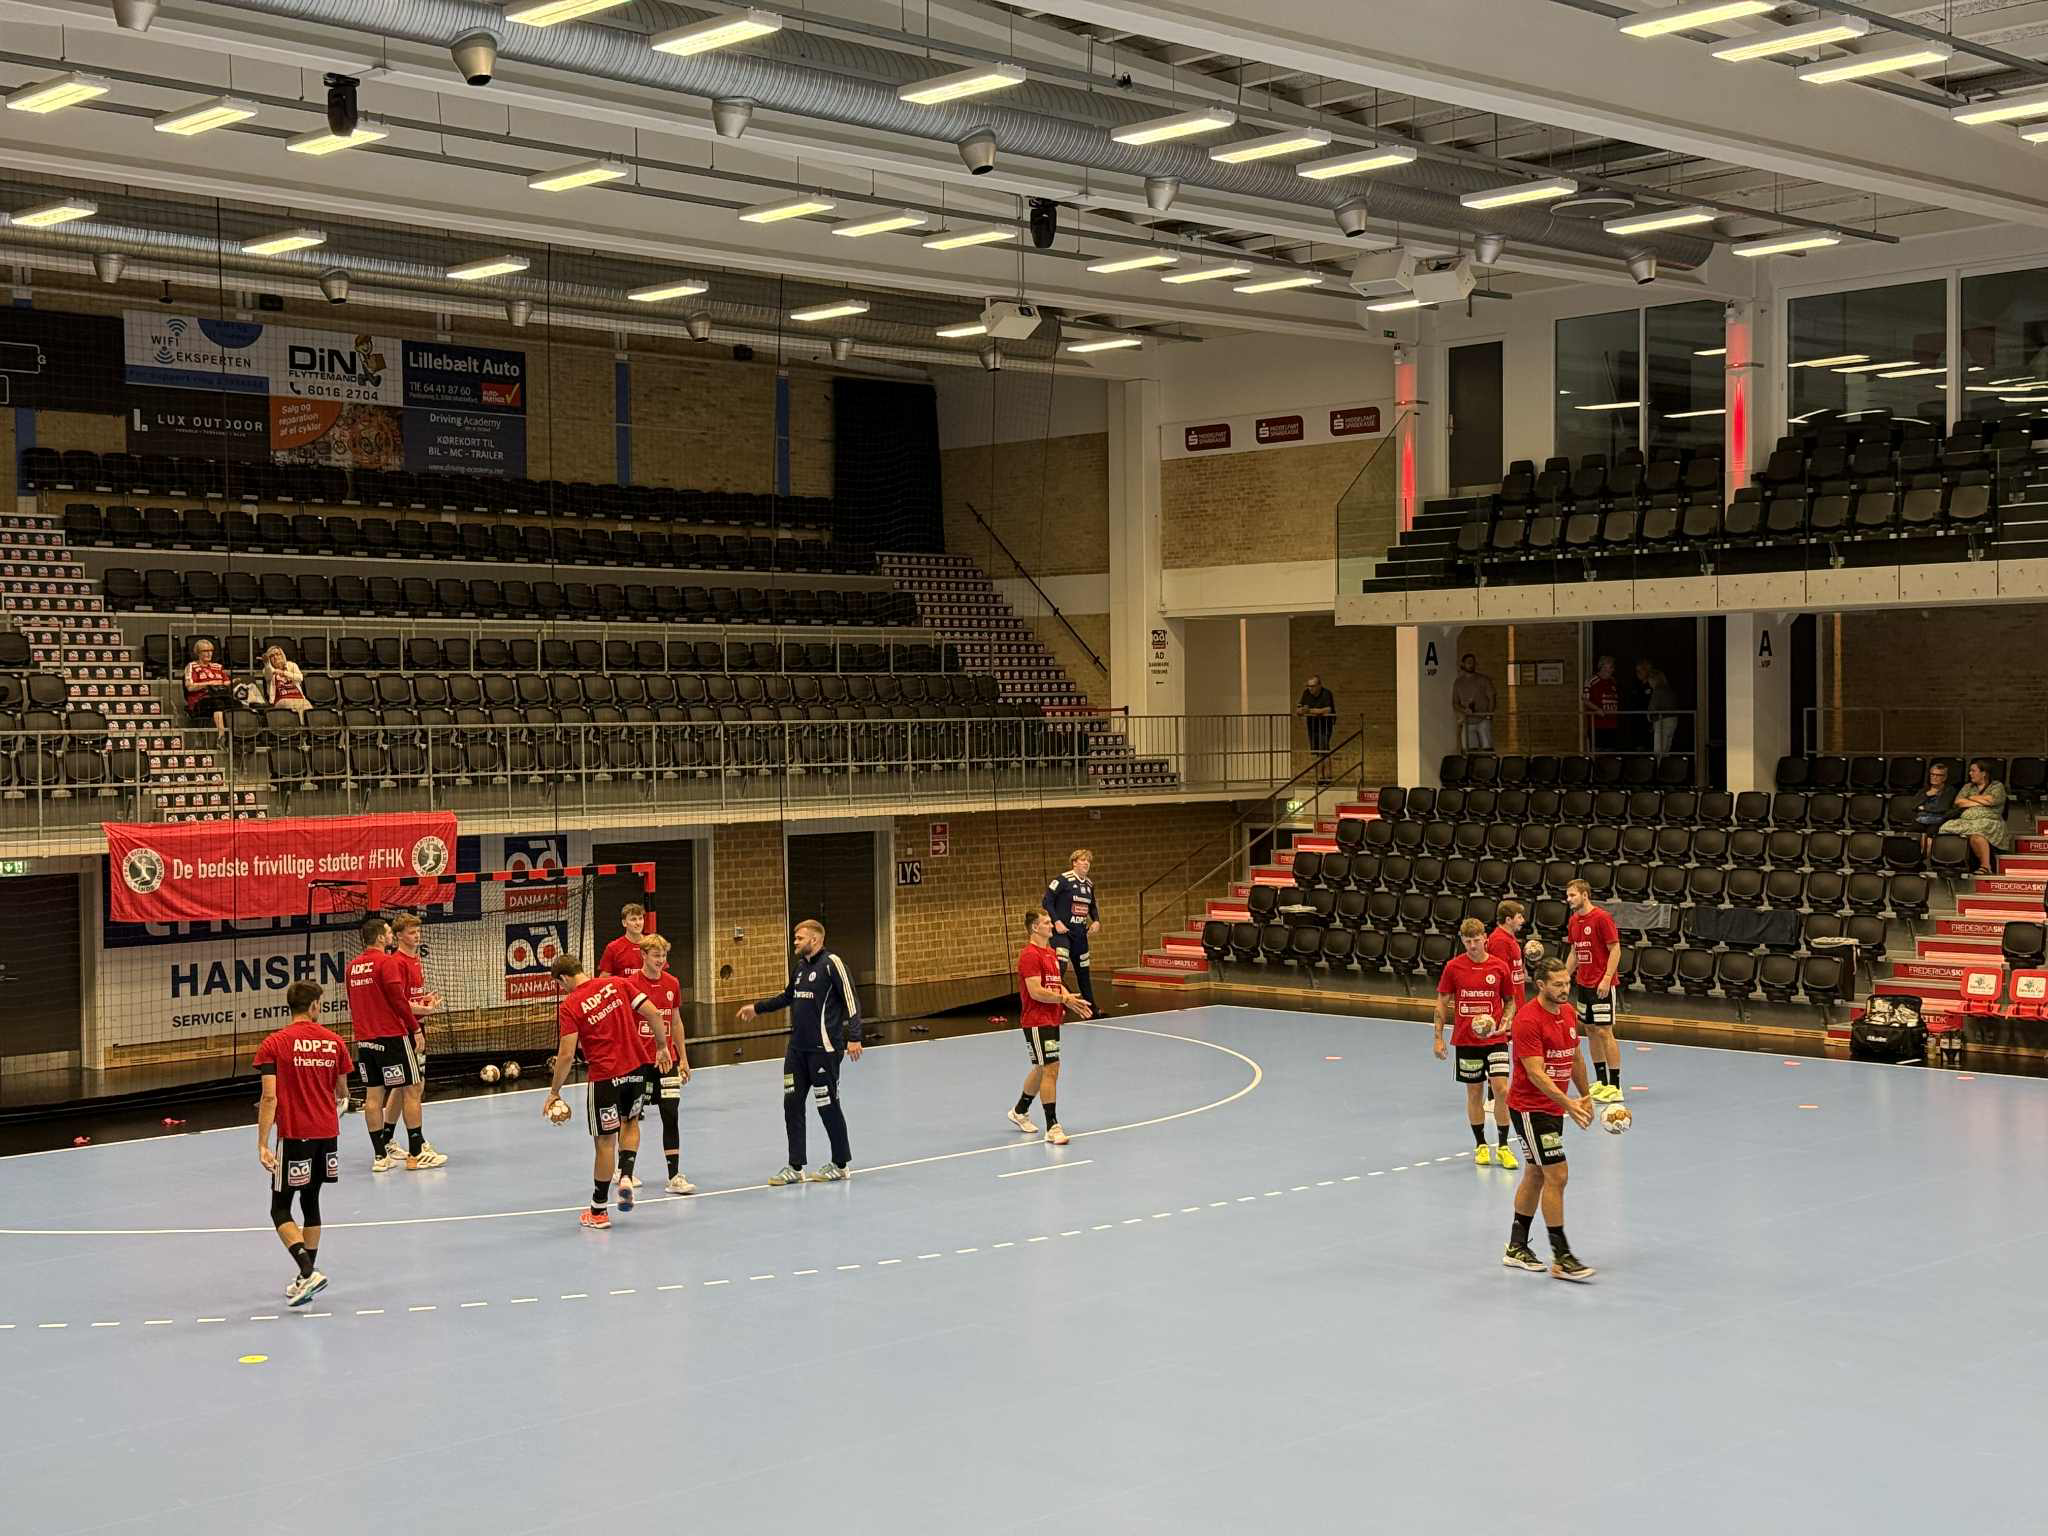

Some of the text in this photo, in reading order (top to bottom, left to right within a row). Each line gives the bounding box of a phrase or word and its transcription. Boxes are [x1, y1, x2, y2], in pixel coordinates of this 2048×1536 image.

[151, 335, 179, 346] WIFI
[176, 352, 252, 368] EKSPERTEN
[409, 352, 520, 377] Lillebælt Auto
[308, 385, 379, 401] 6016 2704
[423, 383, 434, 394] 64
[436, 385, 446, 395] 41
[156, 413, 186, 427] LUX
[429, 412, 462, 427] Driving
[463, 416, 502, 431] Academy
[482, 438, 496, 449] TIL
[428, 446, 504, 462] BIL MC TRAILER
[1759, 630, 1773, 657] A
[1154, 652, 1165, 660] AD
[1425, 641, 1439, 665] A
[172, 858, 193, 880] De
[198, 857, 249, 880] bedste
[253, 854, 315, 880] frivillige
[318, 852, 365, 874] støtter
[367, 847, 406, 869] #FHK
[898, 862, 921, 884] LYS
[509, 894, 566, 909] DANMARK
[171, 952, 345, 999] HANSEN
[172, 1010, 234, 1029] SERVICE
[587, 997, 624, 1026] thansen
[293, 1056, 336, 1068] thansen
